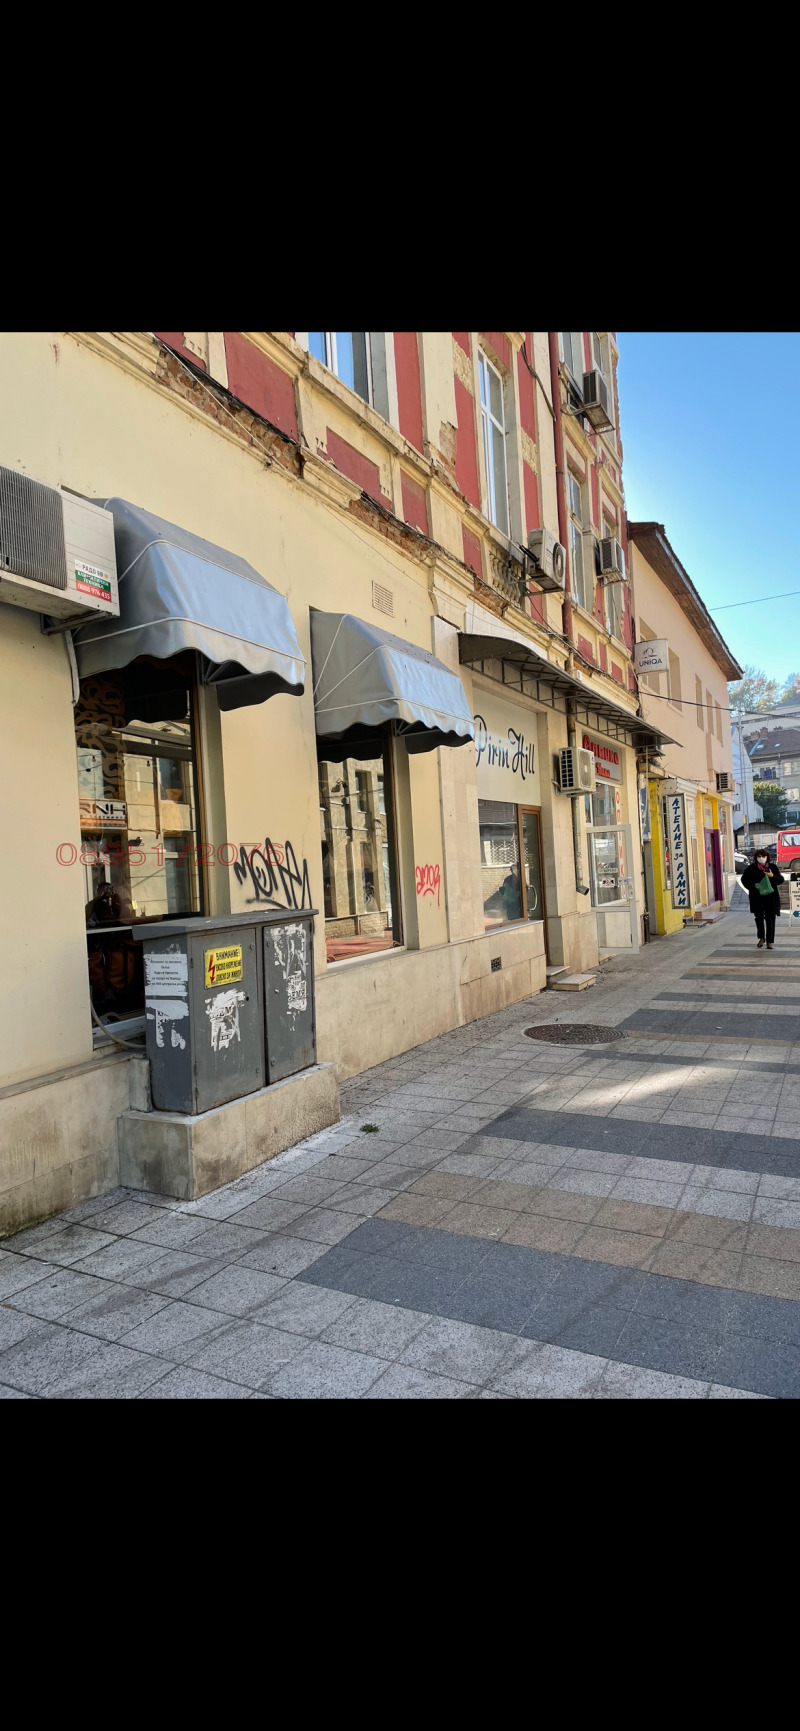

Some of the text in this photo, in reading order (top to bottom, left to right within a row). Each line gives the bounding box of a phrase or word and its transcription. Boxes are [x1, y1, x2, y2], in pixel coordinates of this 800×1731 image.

[90, 587, 101, 597] 976
[101, 592, 111, 601] 435
[638, 658, 663, 668] UNIQA
[473, 714, 536, 781] Pirin Hill
[671, 797, 684, 850] АТЕЛИЕ
[675, 862, 687, 906] РАМКИ
